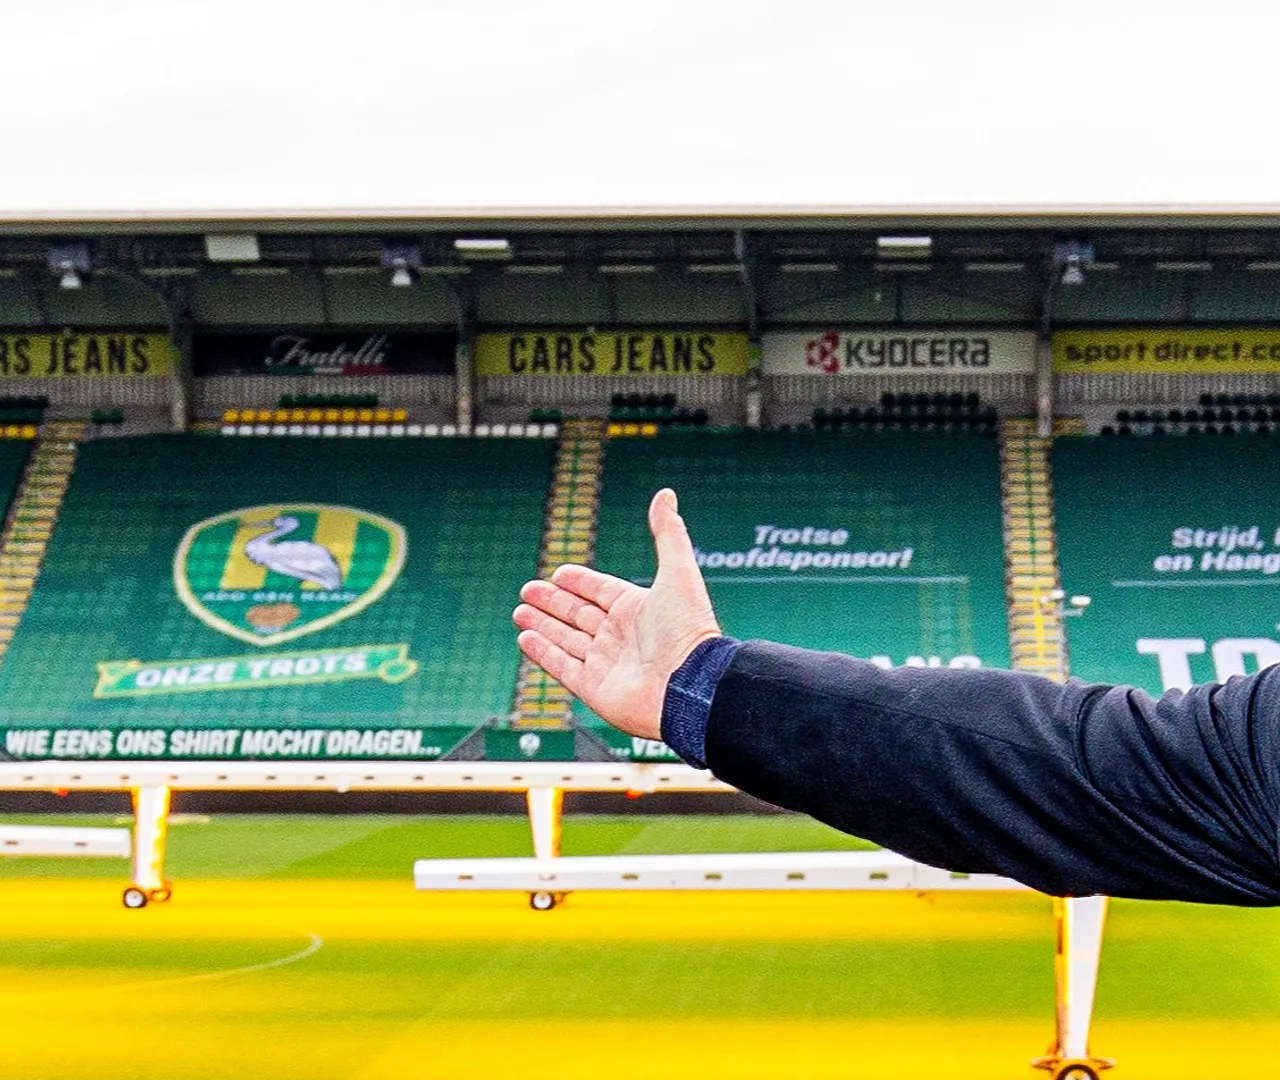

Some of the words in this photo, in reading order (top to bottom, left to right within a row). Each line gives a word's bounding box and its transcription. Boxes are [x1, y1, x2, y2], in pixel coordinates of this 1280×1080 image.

[46, 336, 151, 374] JEANS
[265, 335, 389, 368] Fratelli
[508, 335, 596, 375] CARS
[609, 335, 716, 375] JEANS
[754, 524, 849, 546] Trotse
[1171, 525, 1264, 551] Strijd,
[1153, 554, 1193, 572] en
[135, 659, 237, 689] ONZE
[247, 651, 370, 682] TROTS
[6, 729, 50, 755] WIE
[51, 729, 117, 755] EENS
[120, 730, 166, 755] ONS
[170, 730, 242, 755] SHIRT
[245, 730, 327, 755] MOCHT
